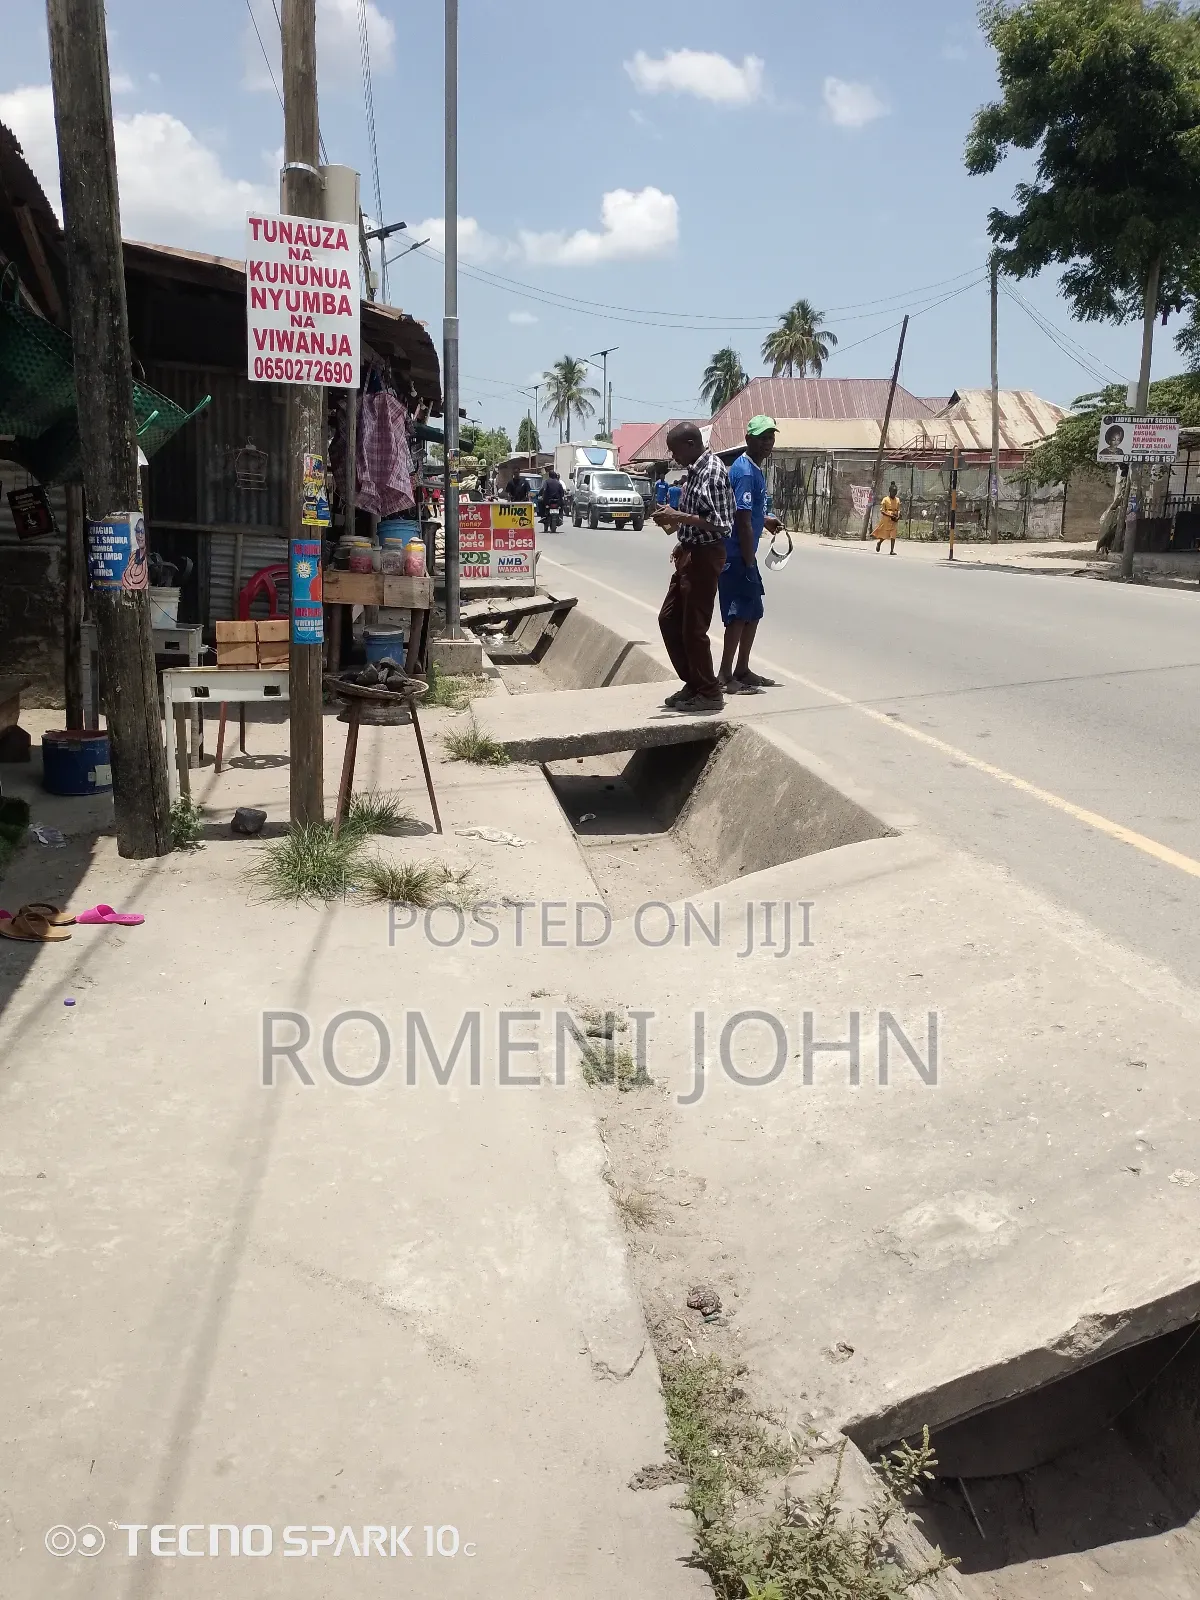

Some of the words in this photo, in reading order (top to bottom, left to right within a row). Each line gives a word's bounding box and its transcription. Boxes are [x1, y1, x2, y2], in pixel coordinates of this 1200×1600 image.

[248, 217, 350, 251] TUNAUZA
[288, 246, 313, 262] NA
[249, 260, 352, 290] KUNUNUA
[251, 286, 353, 317] NYUMBA
[290, 314, 316, 329] NA
[252, 327, 353, 357] VIWANJA
[254, 356, 353, 384] 0650272690
[459, 540, 485, 550] pesa
[495, 538, 534, 550] m-pesa
[459, 551, 491, 565] RDB
[498, 557, 522, 566] NMB
[459, 565, 490, 578] UKU
